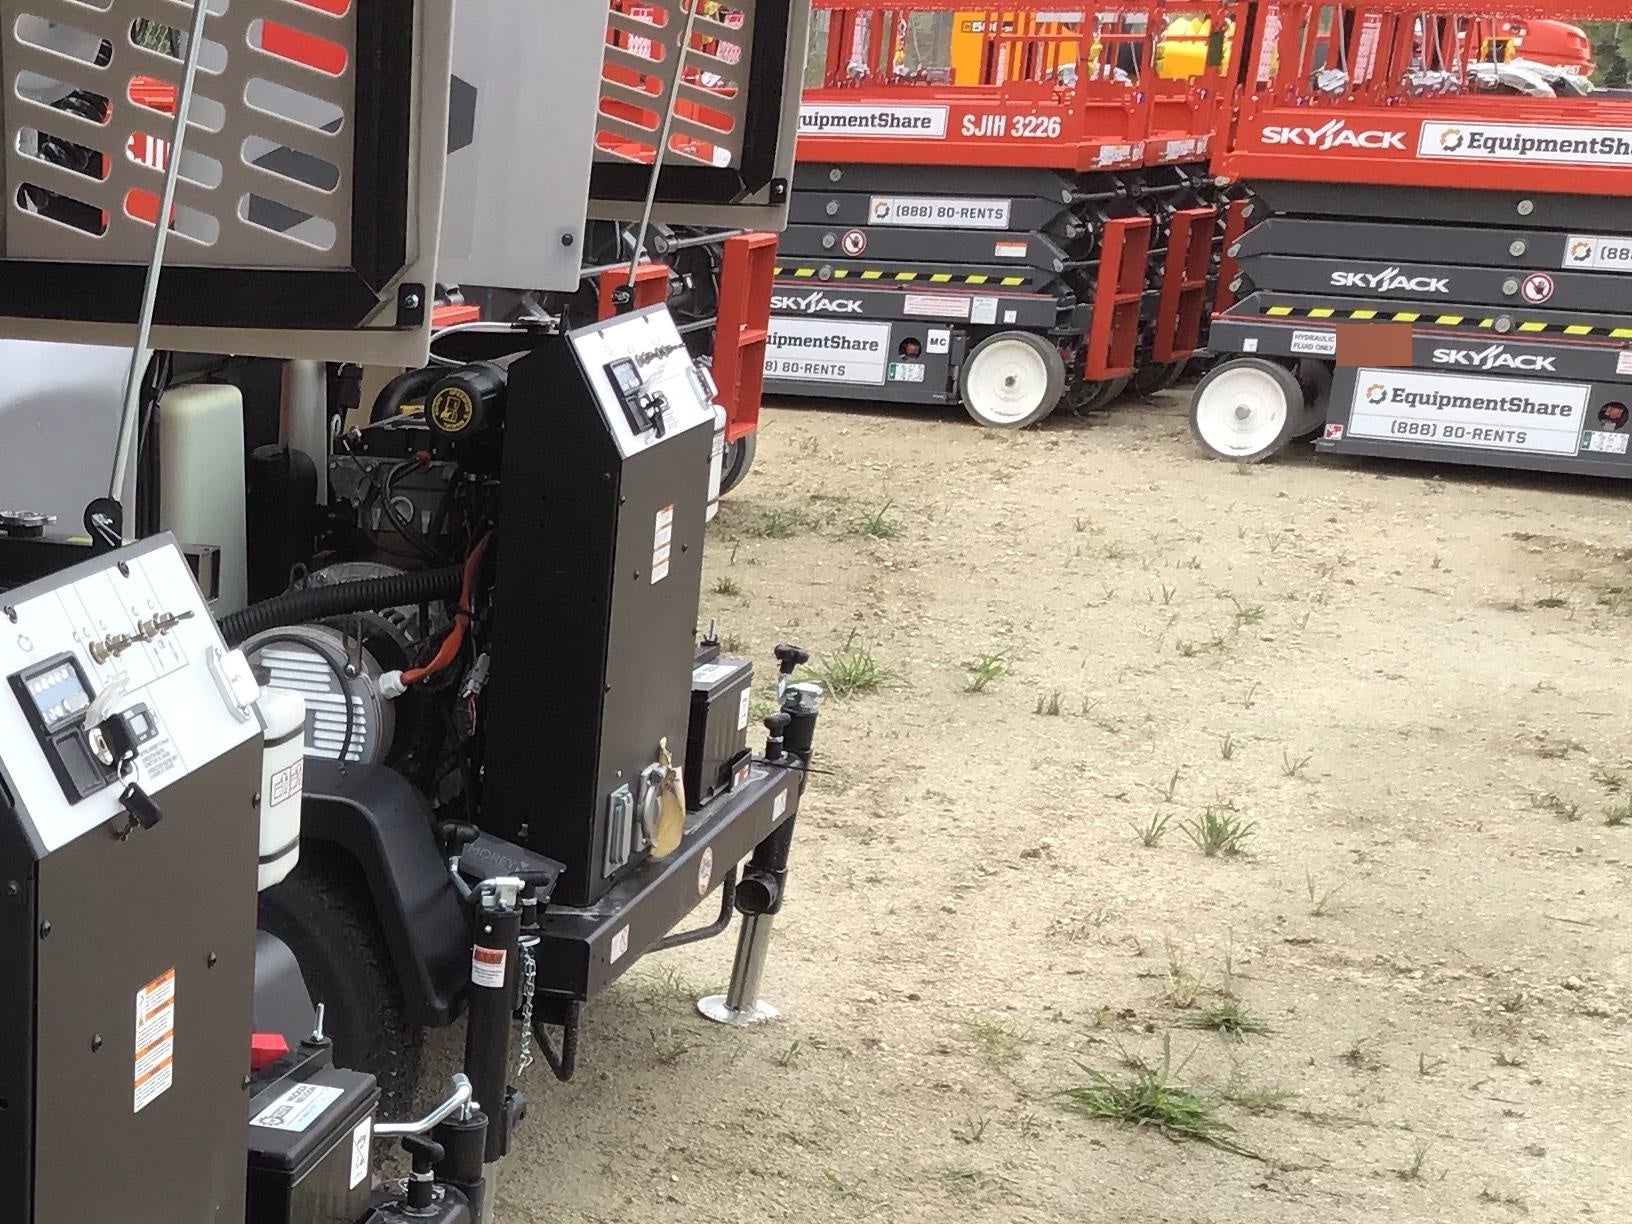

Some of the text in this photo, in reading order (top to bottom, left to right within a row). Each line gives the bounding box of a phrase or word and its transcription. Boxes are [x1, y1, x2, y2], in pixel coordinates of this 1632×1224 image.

[961, 115, 1061, 138] SJIH 3226
[1261, 119, 1406, 150] SKYJACK
[896, 206, 1004, 220] (888) 80-RENTS
[1330, 266, 1449, 293] SKYJACK
[770, 291, 863, 314] SKYJACK
[930, 338, 946, 347] MC
[1315, 344, 1334, 352] ONLY
[782, 362, 846, 376] 80-RENTS
[1432, 344, 1557, 371] SKYJACK
[1390, 387, 1573, 417] EquipmentShare
[1391, 420, 1528, 444] (888) 80-RENTS
